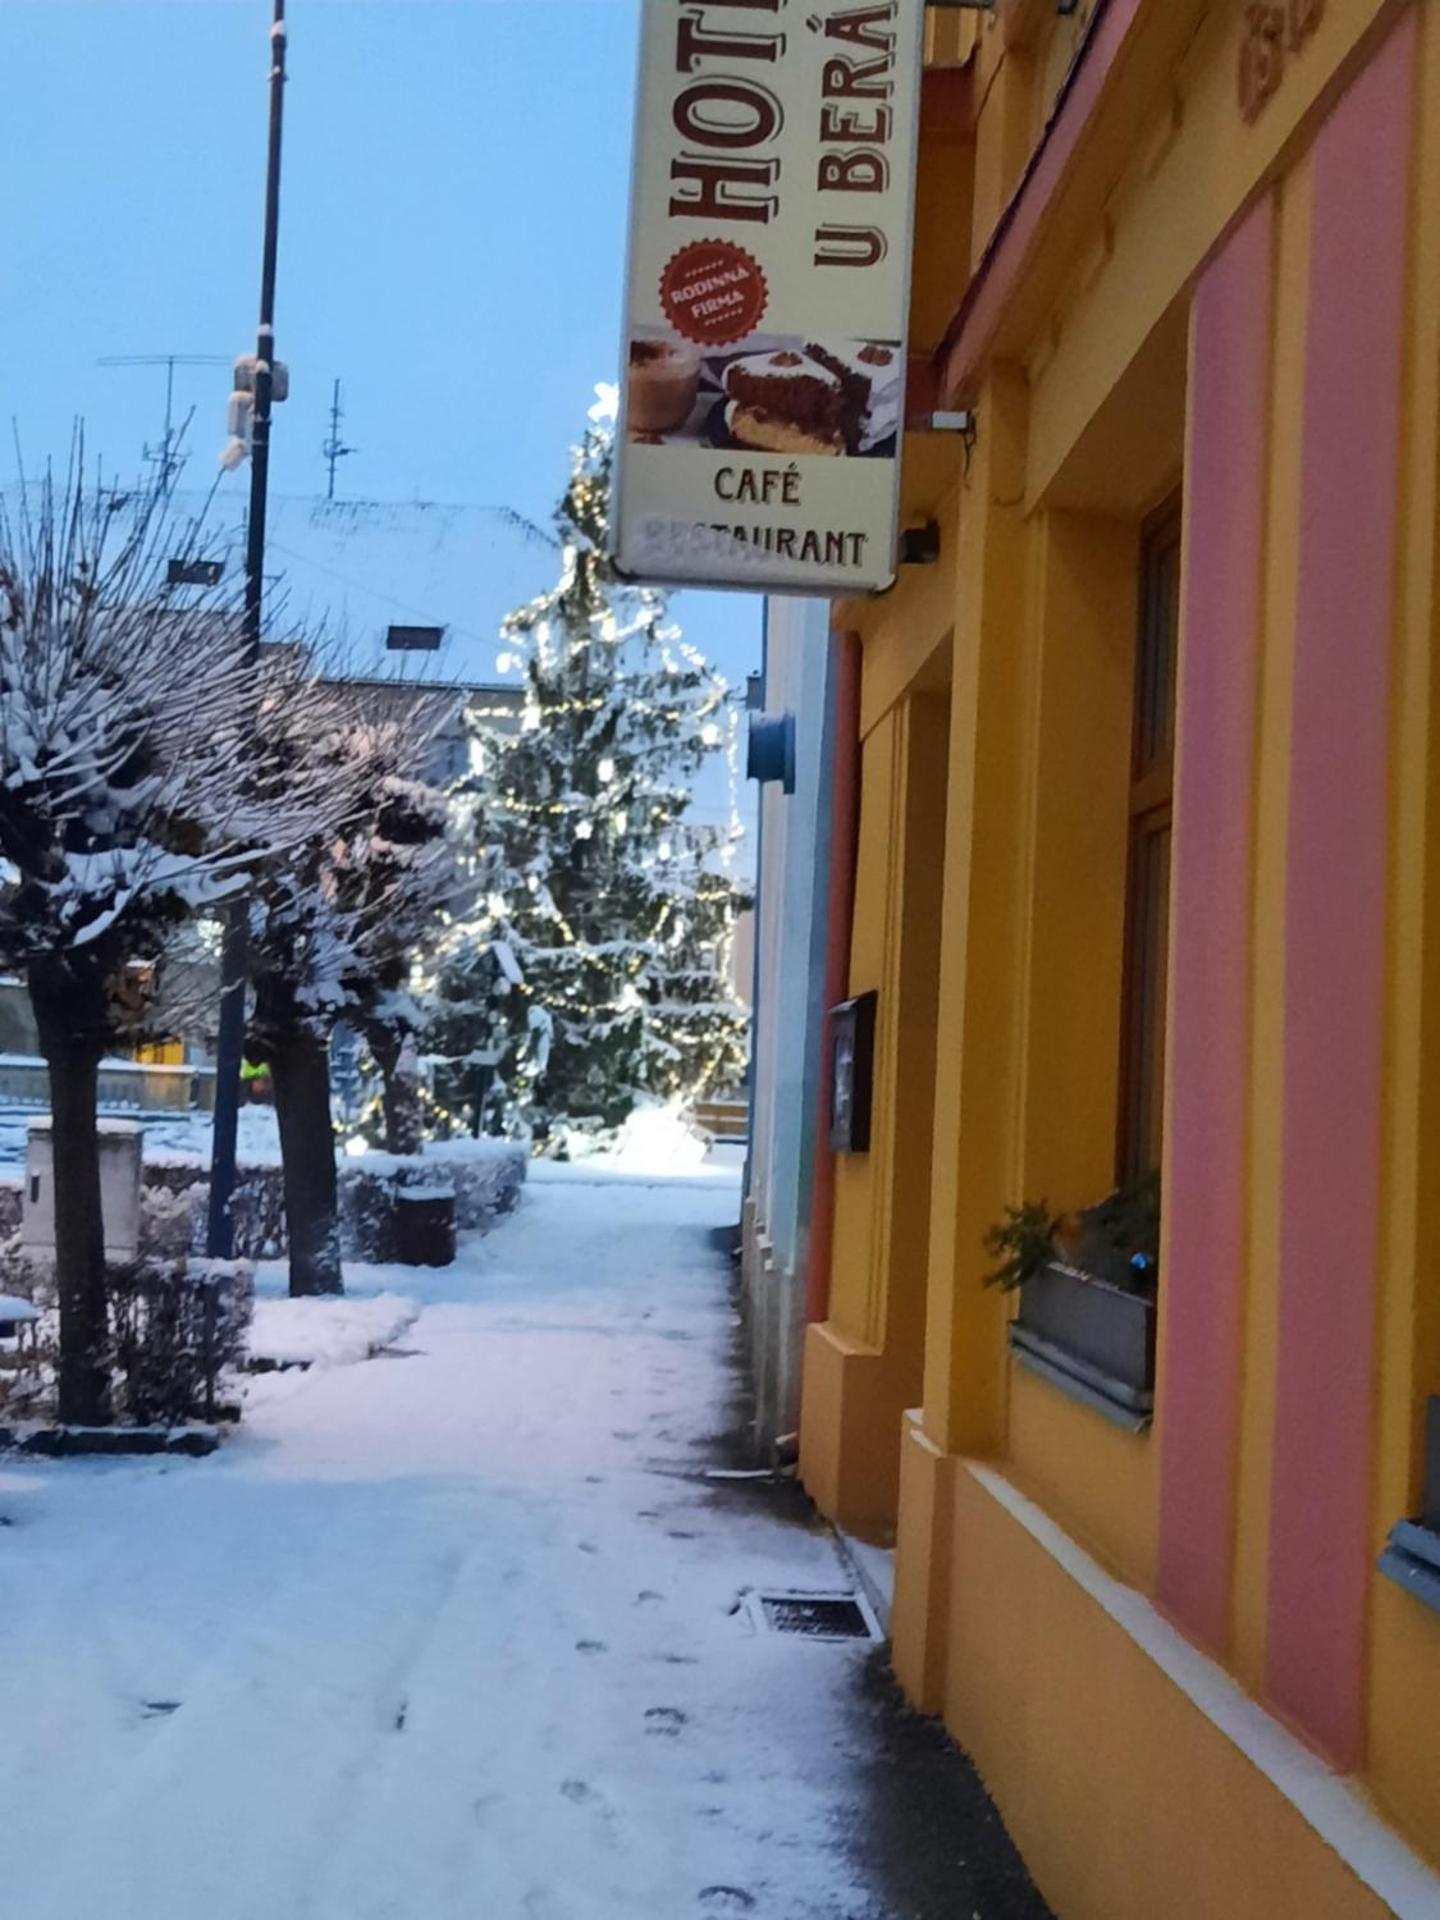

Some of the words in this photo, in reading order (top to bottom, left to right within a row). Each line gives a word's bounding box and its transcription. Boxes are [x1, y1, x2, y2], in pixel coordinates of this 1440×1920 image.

[669, 0, 787, 224] HOT
[806, 1, 898, 193] BERÁ
[814, 222, 888, 267] U
[691, 291, 744, 318] FIRMA
[714, 461, 802, 506] CAFÉ
[645, 520, 868, 567] TAURANT
